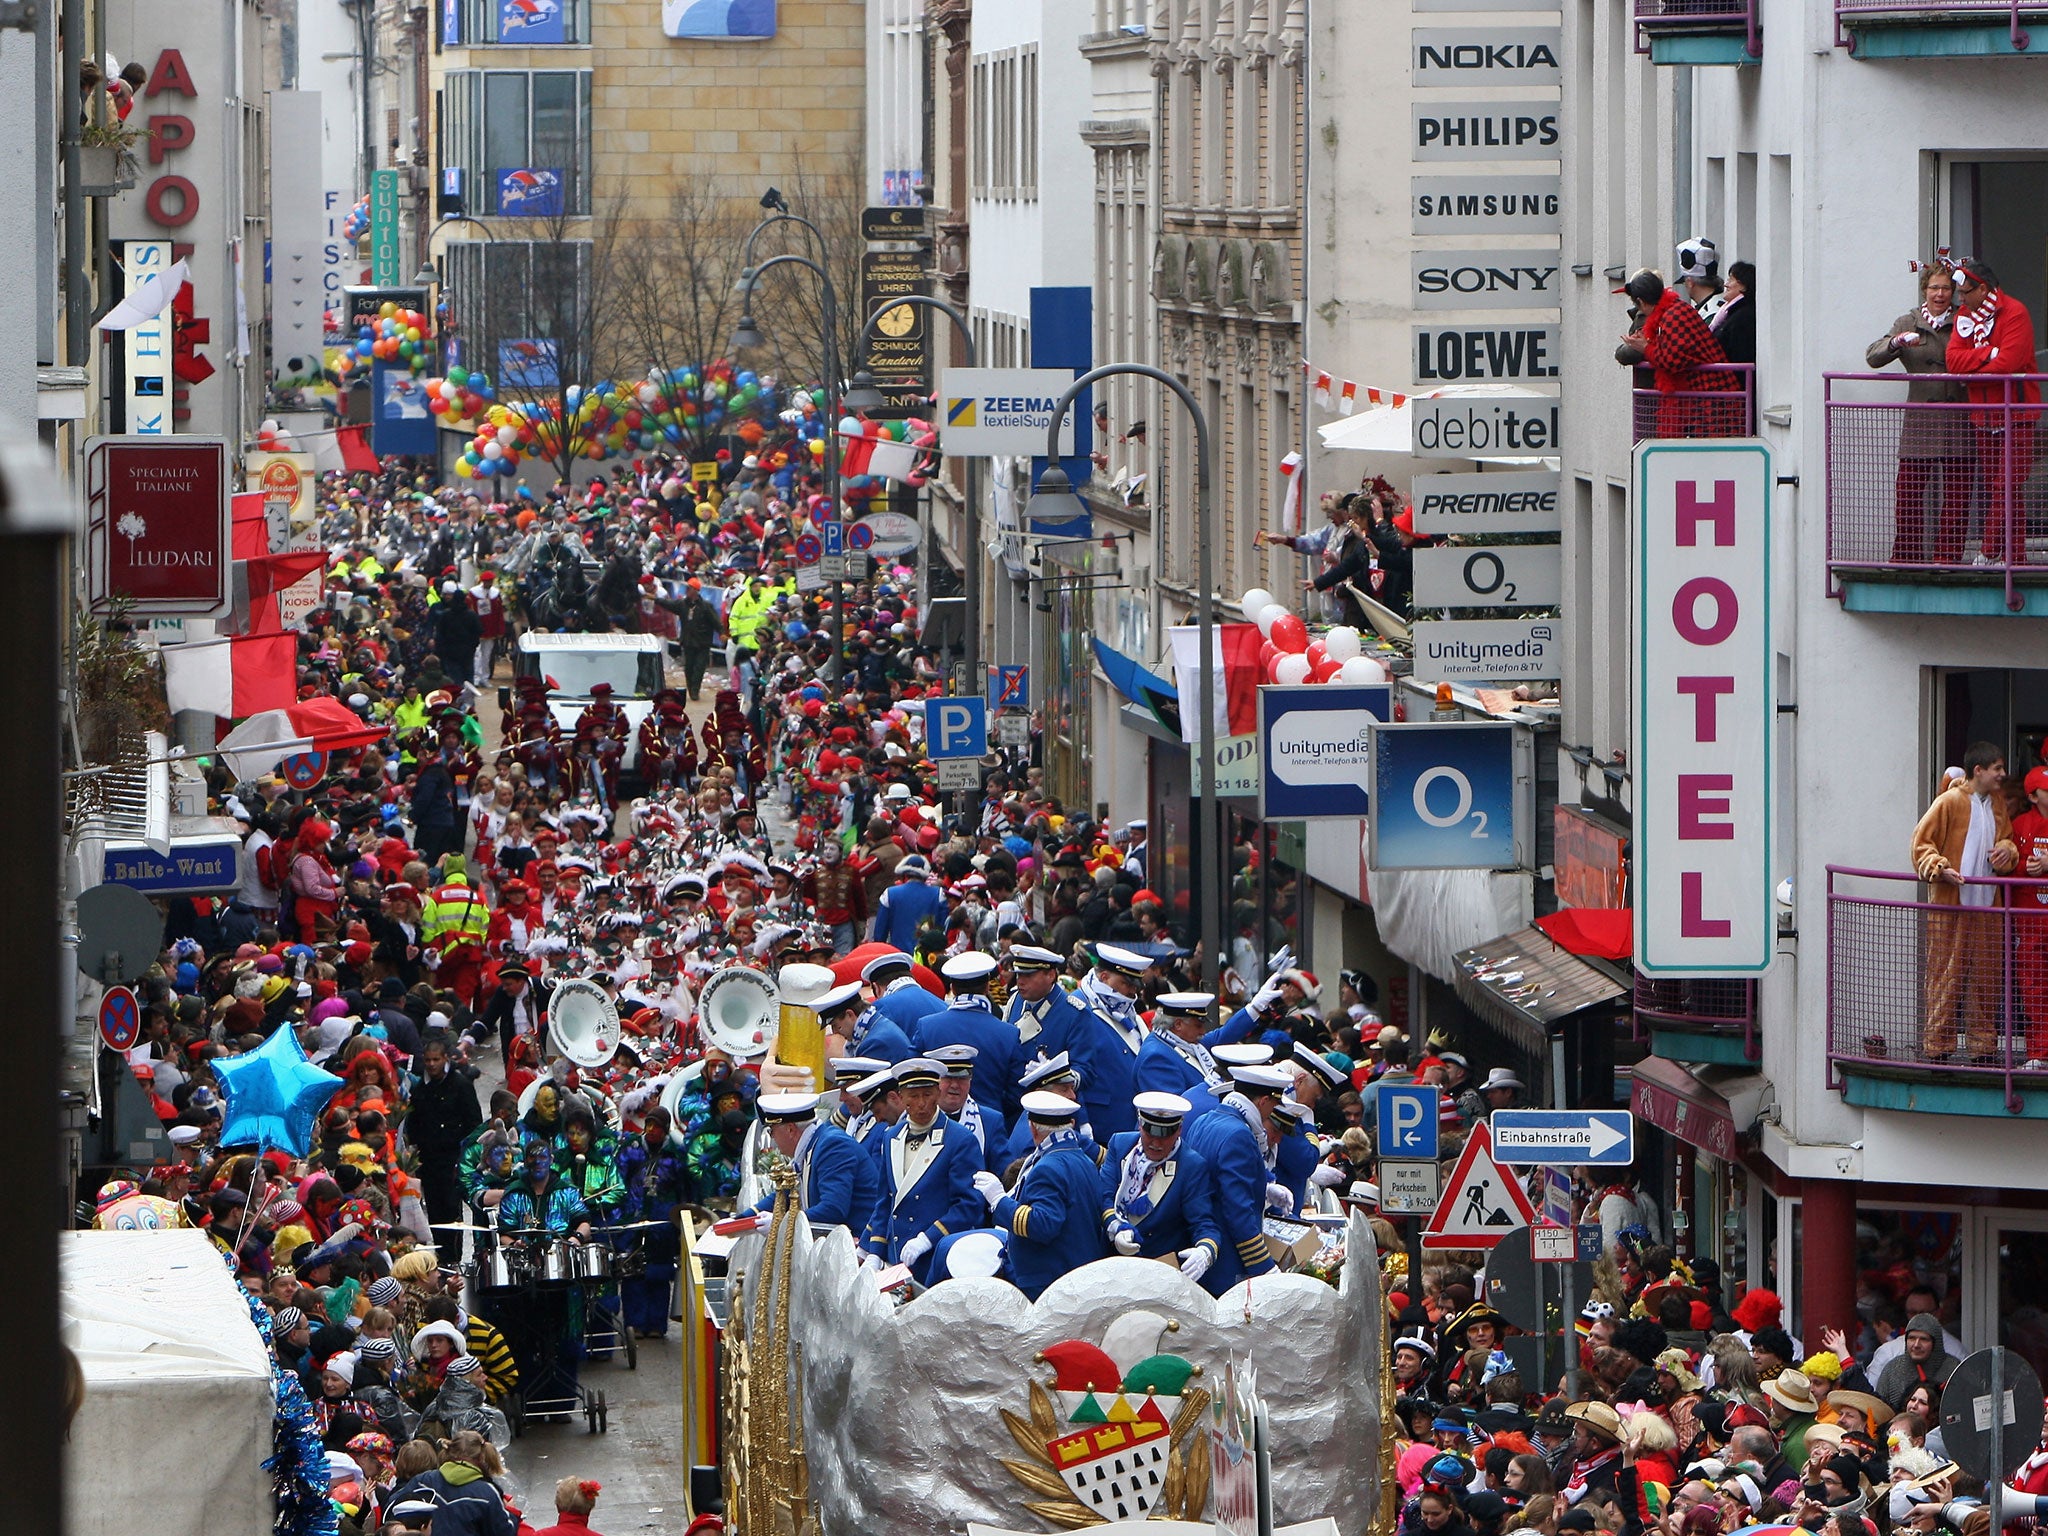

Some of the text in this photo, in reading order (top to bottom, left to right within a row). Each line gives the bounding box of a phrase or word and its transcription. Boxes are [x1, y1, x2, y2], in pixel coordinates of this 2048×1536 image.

[1419, 45, 1559, 68] NOKIA
[1418, 116, 1559, 146] PHILIPS
[1418, 194, 1559, 217] SAMSUNG
[878, 283, 914, 292] UHREN
[1418, 267, 1557, 293] SONY
[872, 341, 921, 350] SCHMUCK
[984, 415, 1070, 430] textielSups
[1418, 407, 1559, 449] debitel
[135, 481, 193, 492] ITALIANE
[1421, 491, 1558, 515] PREMIERE
[284, 598, 316, 607] KIOSK
[283, 611, 295, 620] 42
[1428, 639, 1543, 663] Unitymedia
[1485, 663, 1519, 673] Telefon
[1520, 663, 1529, 671] &
[1530, 663, 1543, 671] TV
[1672, 480, 1739, 938] HOTEL
[940, 705, 972, 751] P
[1280, 738, 1369, 758] Unitymedia
[1391, 1095, 1424, 1148] P
[1500, 1131, 1591, 1144] Einbahnstraße
[1396, 1169, 1422, 1178] nur mit
[1391, 1182, 1427, 1193] Parkschein
